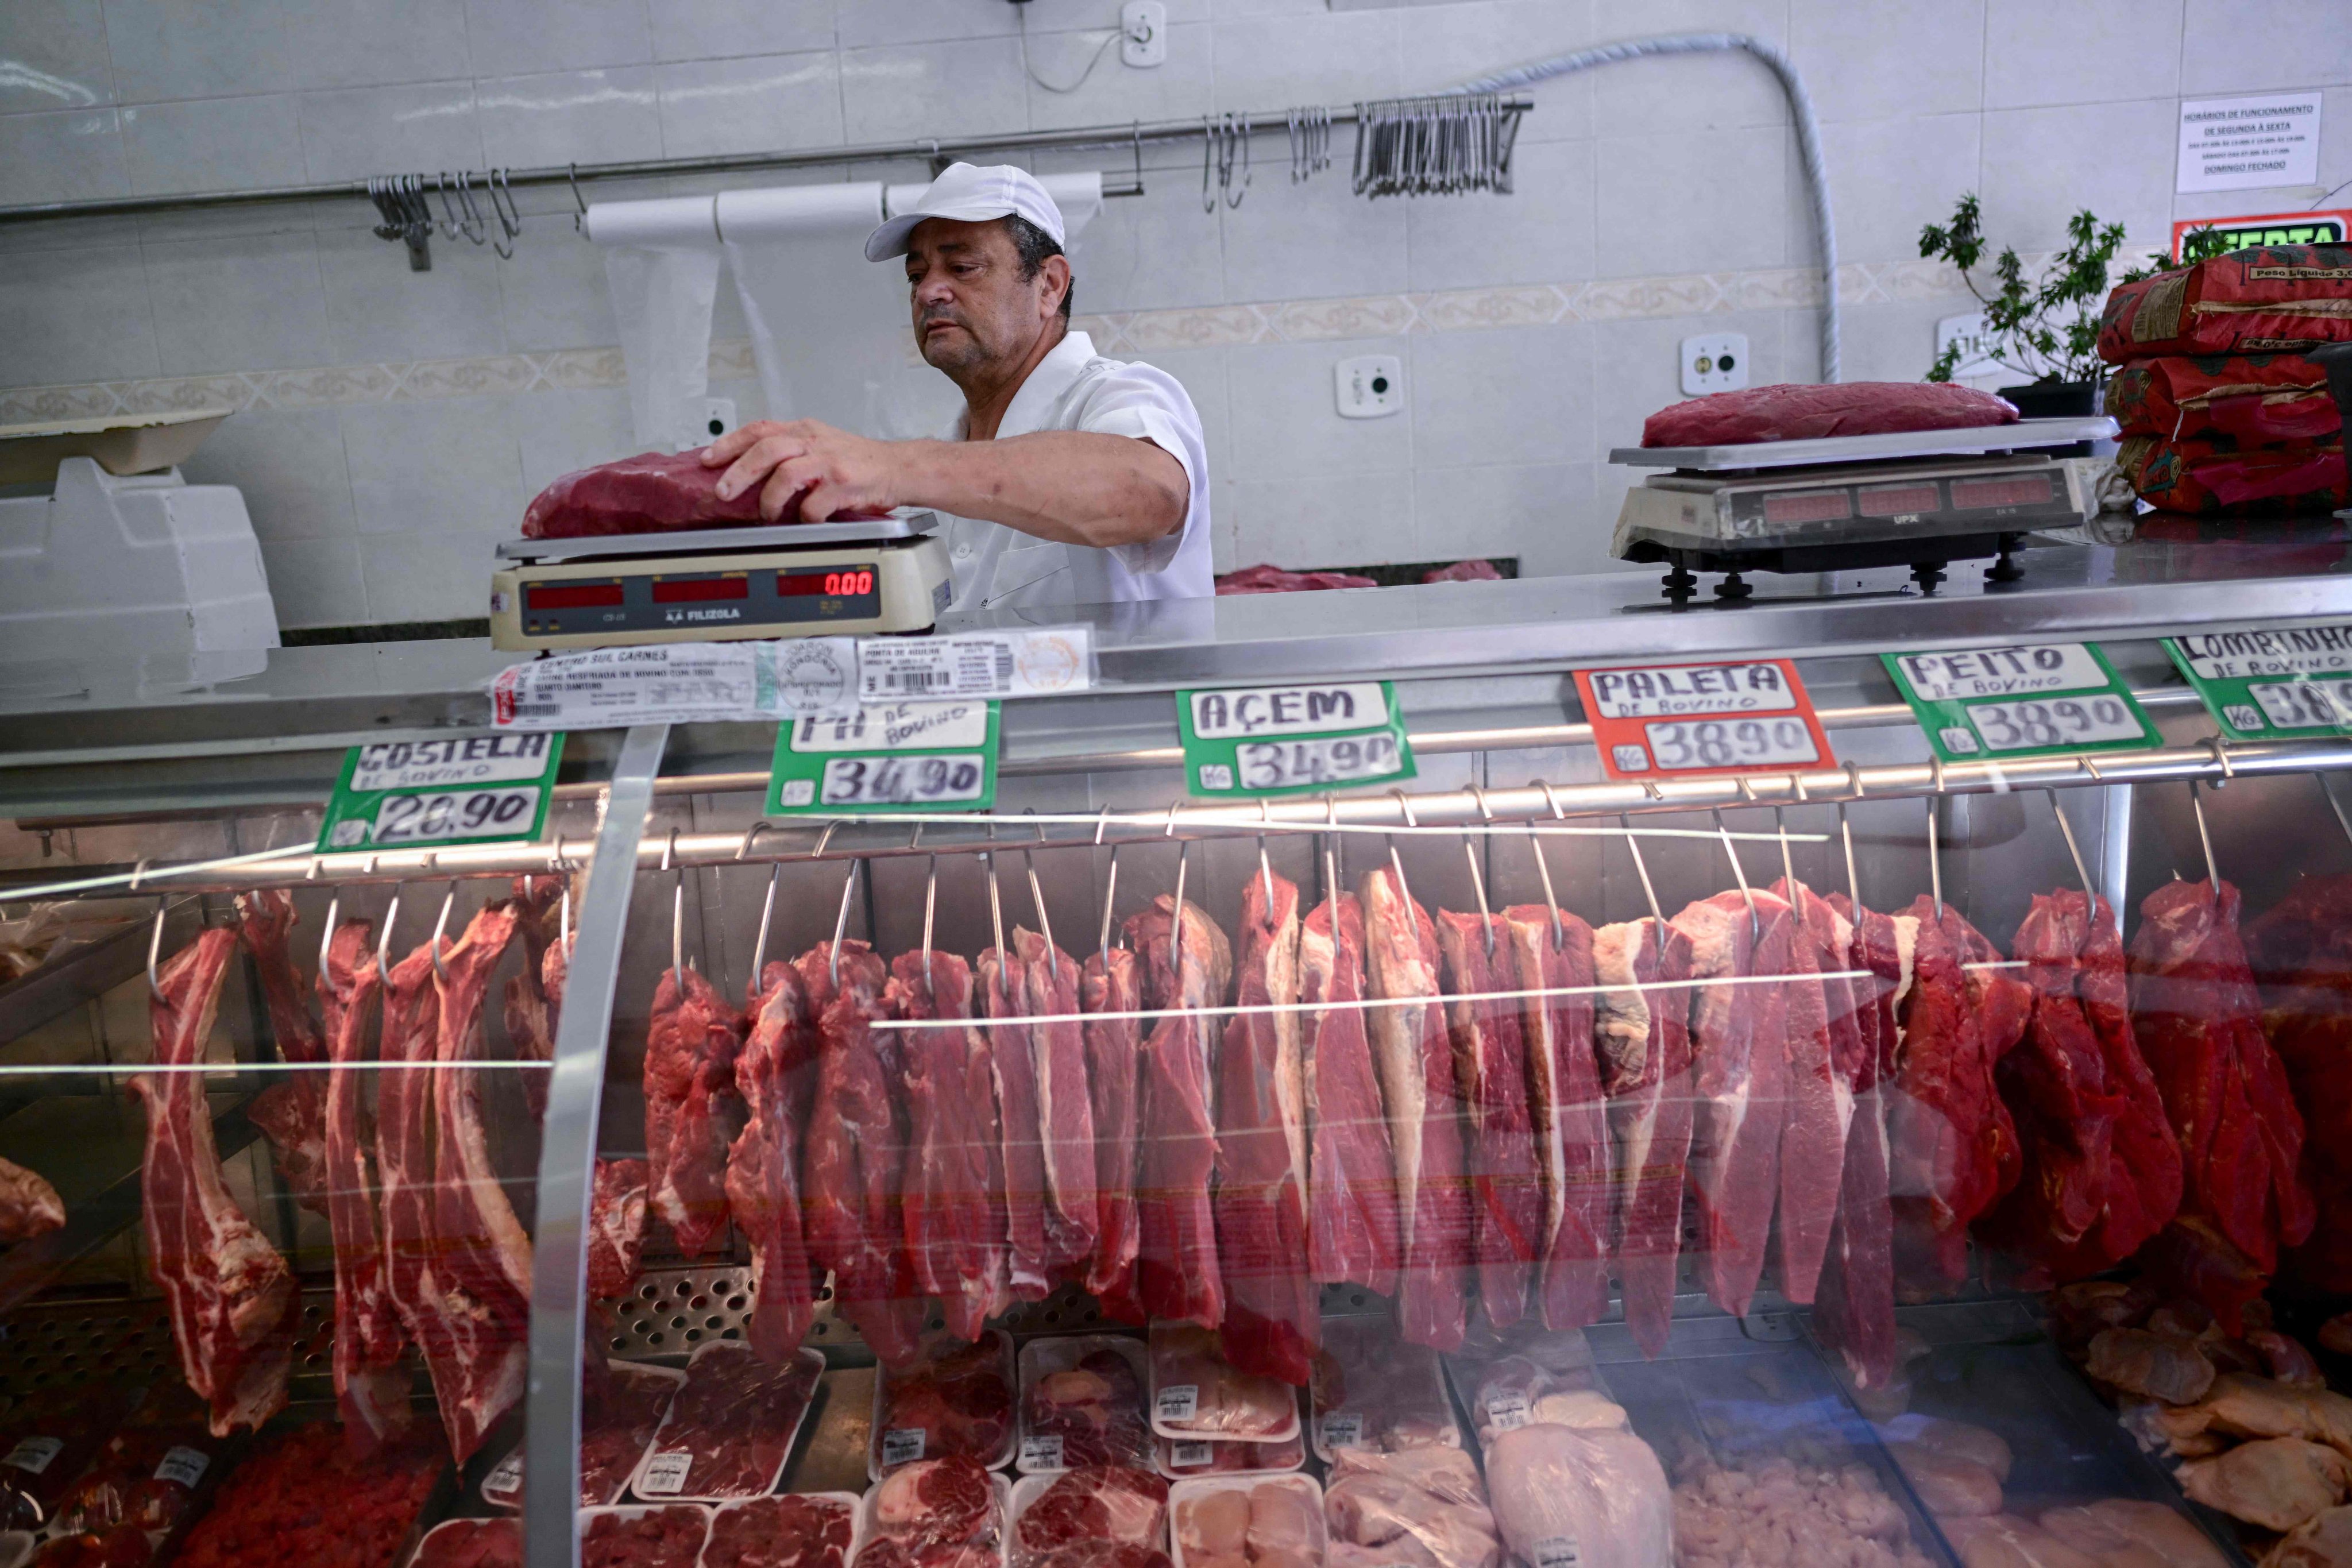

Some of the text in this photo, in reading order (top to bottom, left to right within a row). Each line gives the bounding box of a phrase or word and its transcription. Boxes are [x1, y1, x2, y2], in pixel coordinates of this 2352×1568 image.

[2228, 111, 2238, 119] DE
[2241, 105, 2314, 117] FUNCIONAMENTO
[2204, 127, 2215, 136] DE
[2217, 123, 2256, 134] SEGUNDA
[2266, 122, 2291, 131] SEXTA
[2204, 161, 2285, 174] DOMINGO FECHADO
[1894, 513, 1919, 524] UPX
[688, 608, 740, 620] FILIZOLA
[617, 649, 669, 662] CARNES
[1906, 647, 2063, 685] PEITO
[2213, 662, 2238, 678] DE
[566, 671, 616, 680] RESFRIADA
[634, 670, 667, 678] BOVINO
[1593, 663, 1779, 702] PALETA
[1933, 676, 2062, 698] DE BOVINO
[885, 704, 910, 723] DE
[1199, 690, 1354, 732] AÇEM
[1618, 697, 1756, 717] DE BOVINO
[885, 706, 968, 746] BOVINO
[360, 733, 546, 771] COSTELA
